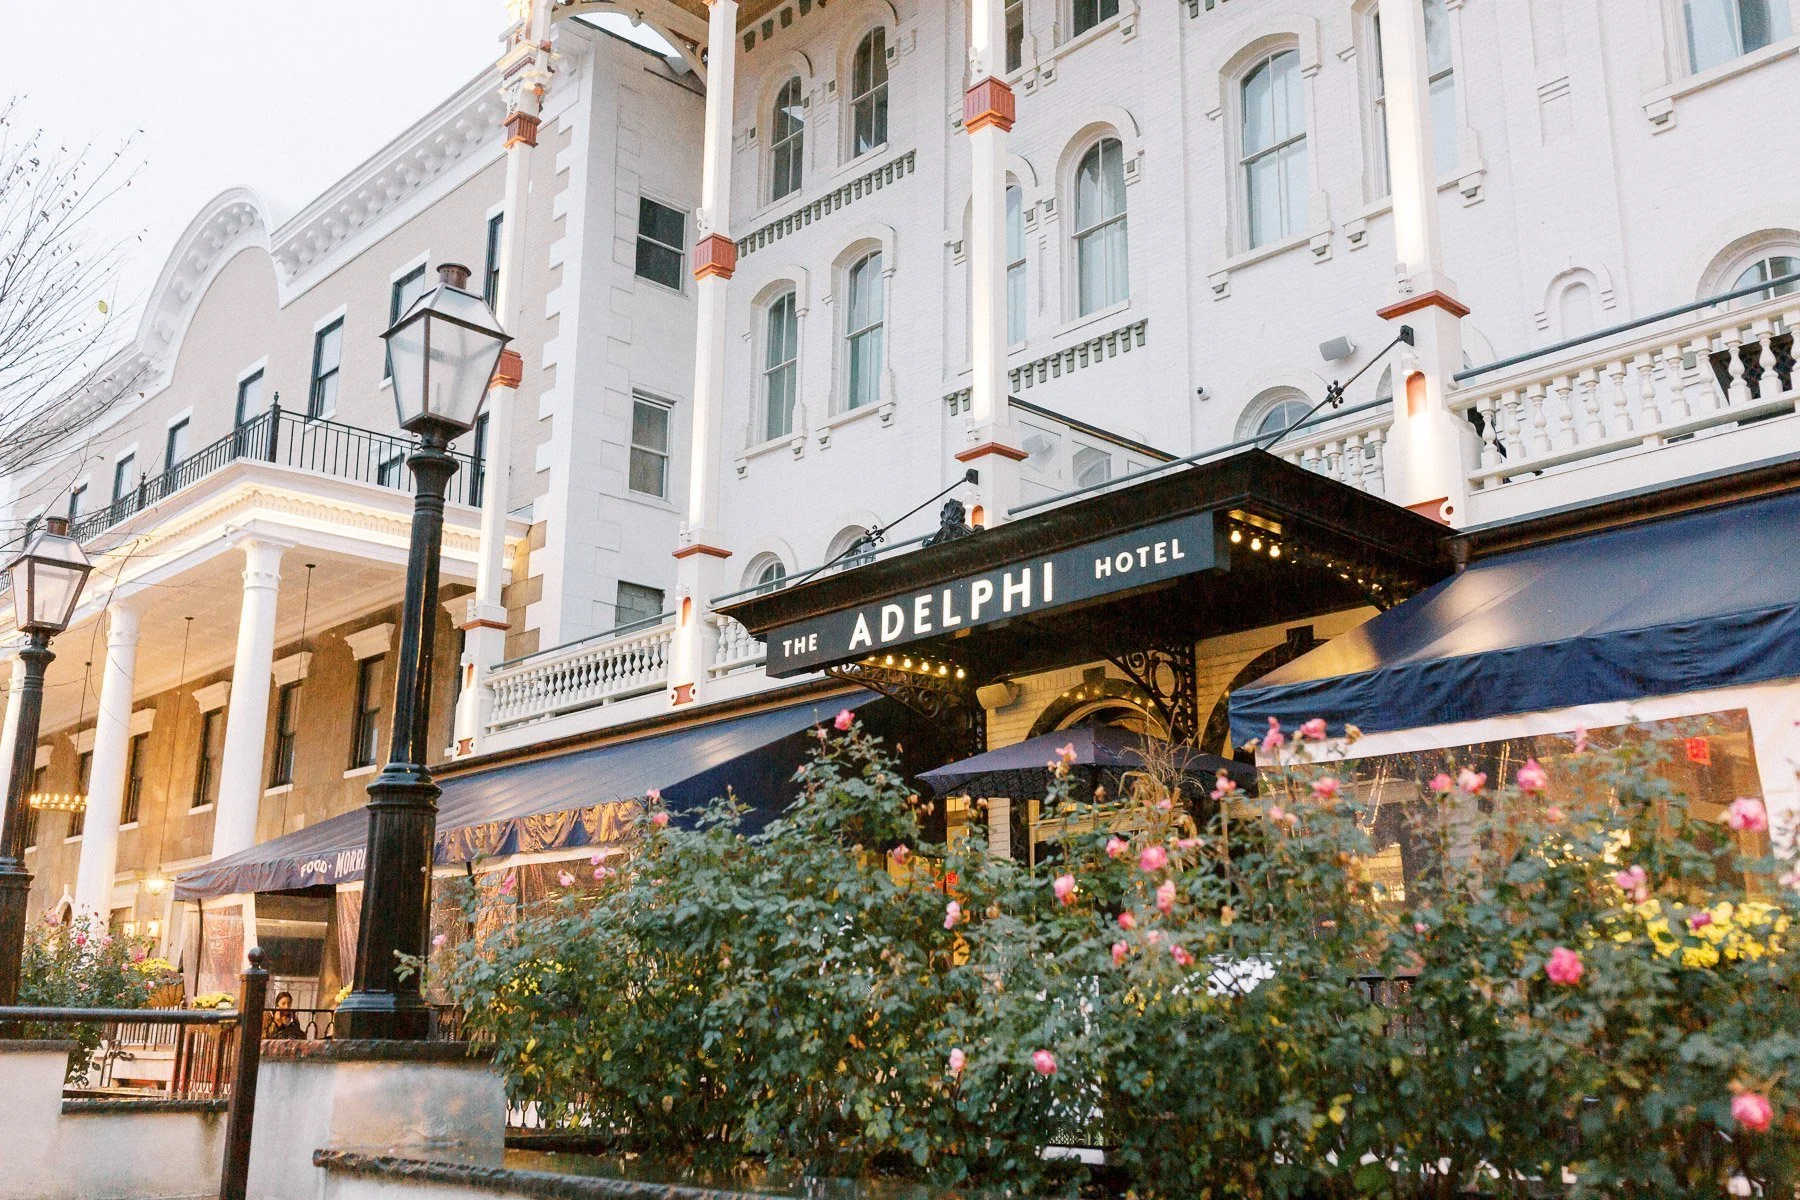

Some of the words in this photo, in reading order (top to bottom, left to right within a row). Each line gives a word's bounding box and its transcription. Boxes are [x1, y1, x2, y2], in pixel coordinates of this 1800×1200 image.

[782, 632, 818, 658] THE
[848, 561, 1054, 651] ADELPHI
[1095, 538, 1185, 579] HOTEL
[300, 859, 328, 878] FOOD
[334, 847, 367, 878] MORRI
